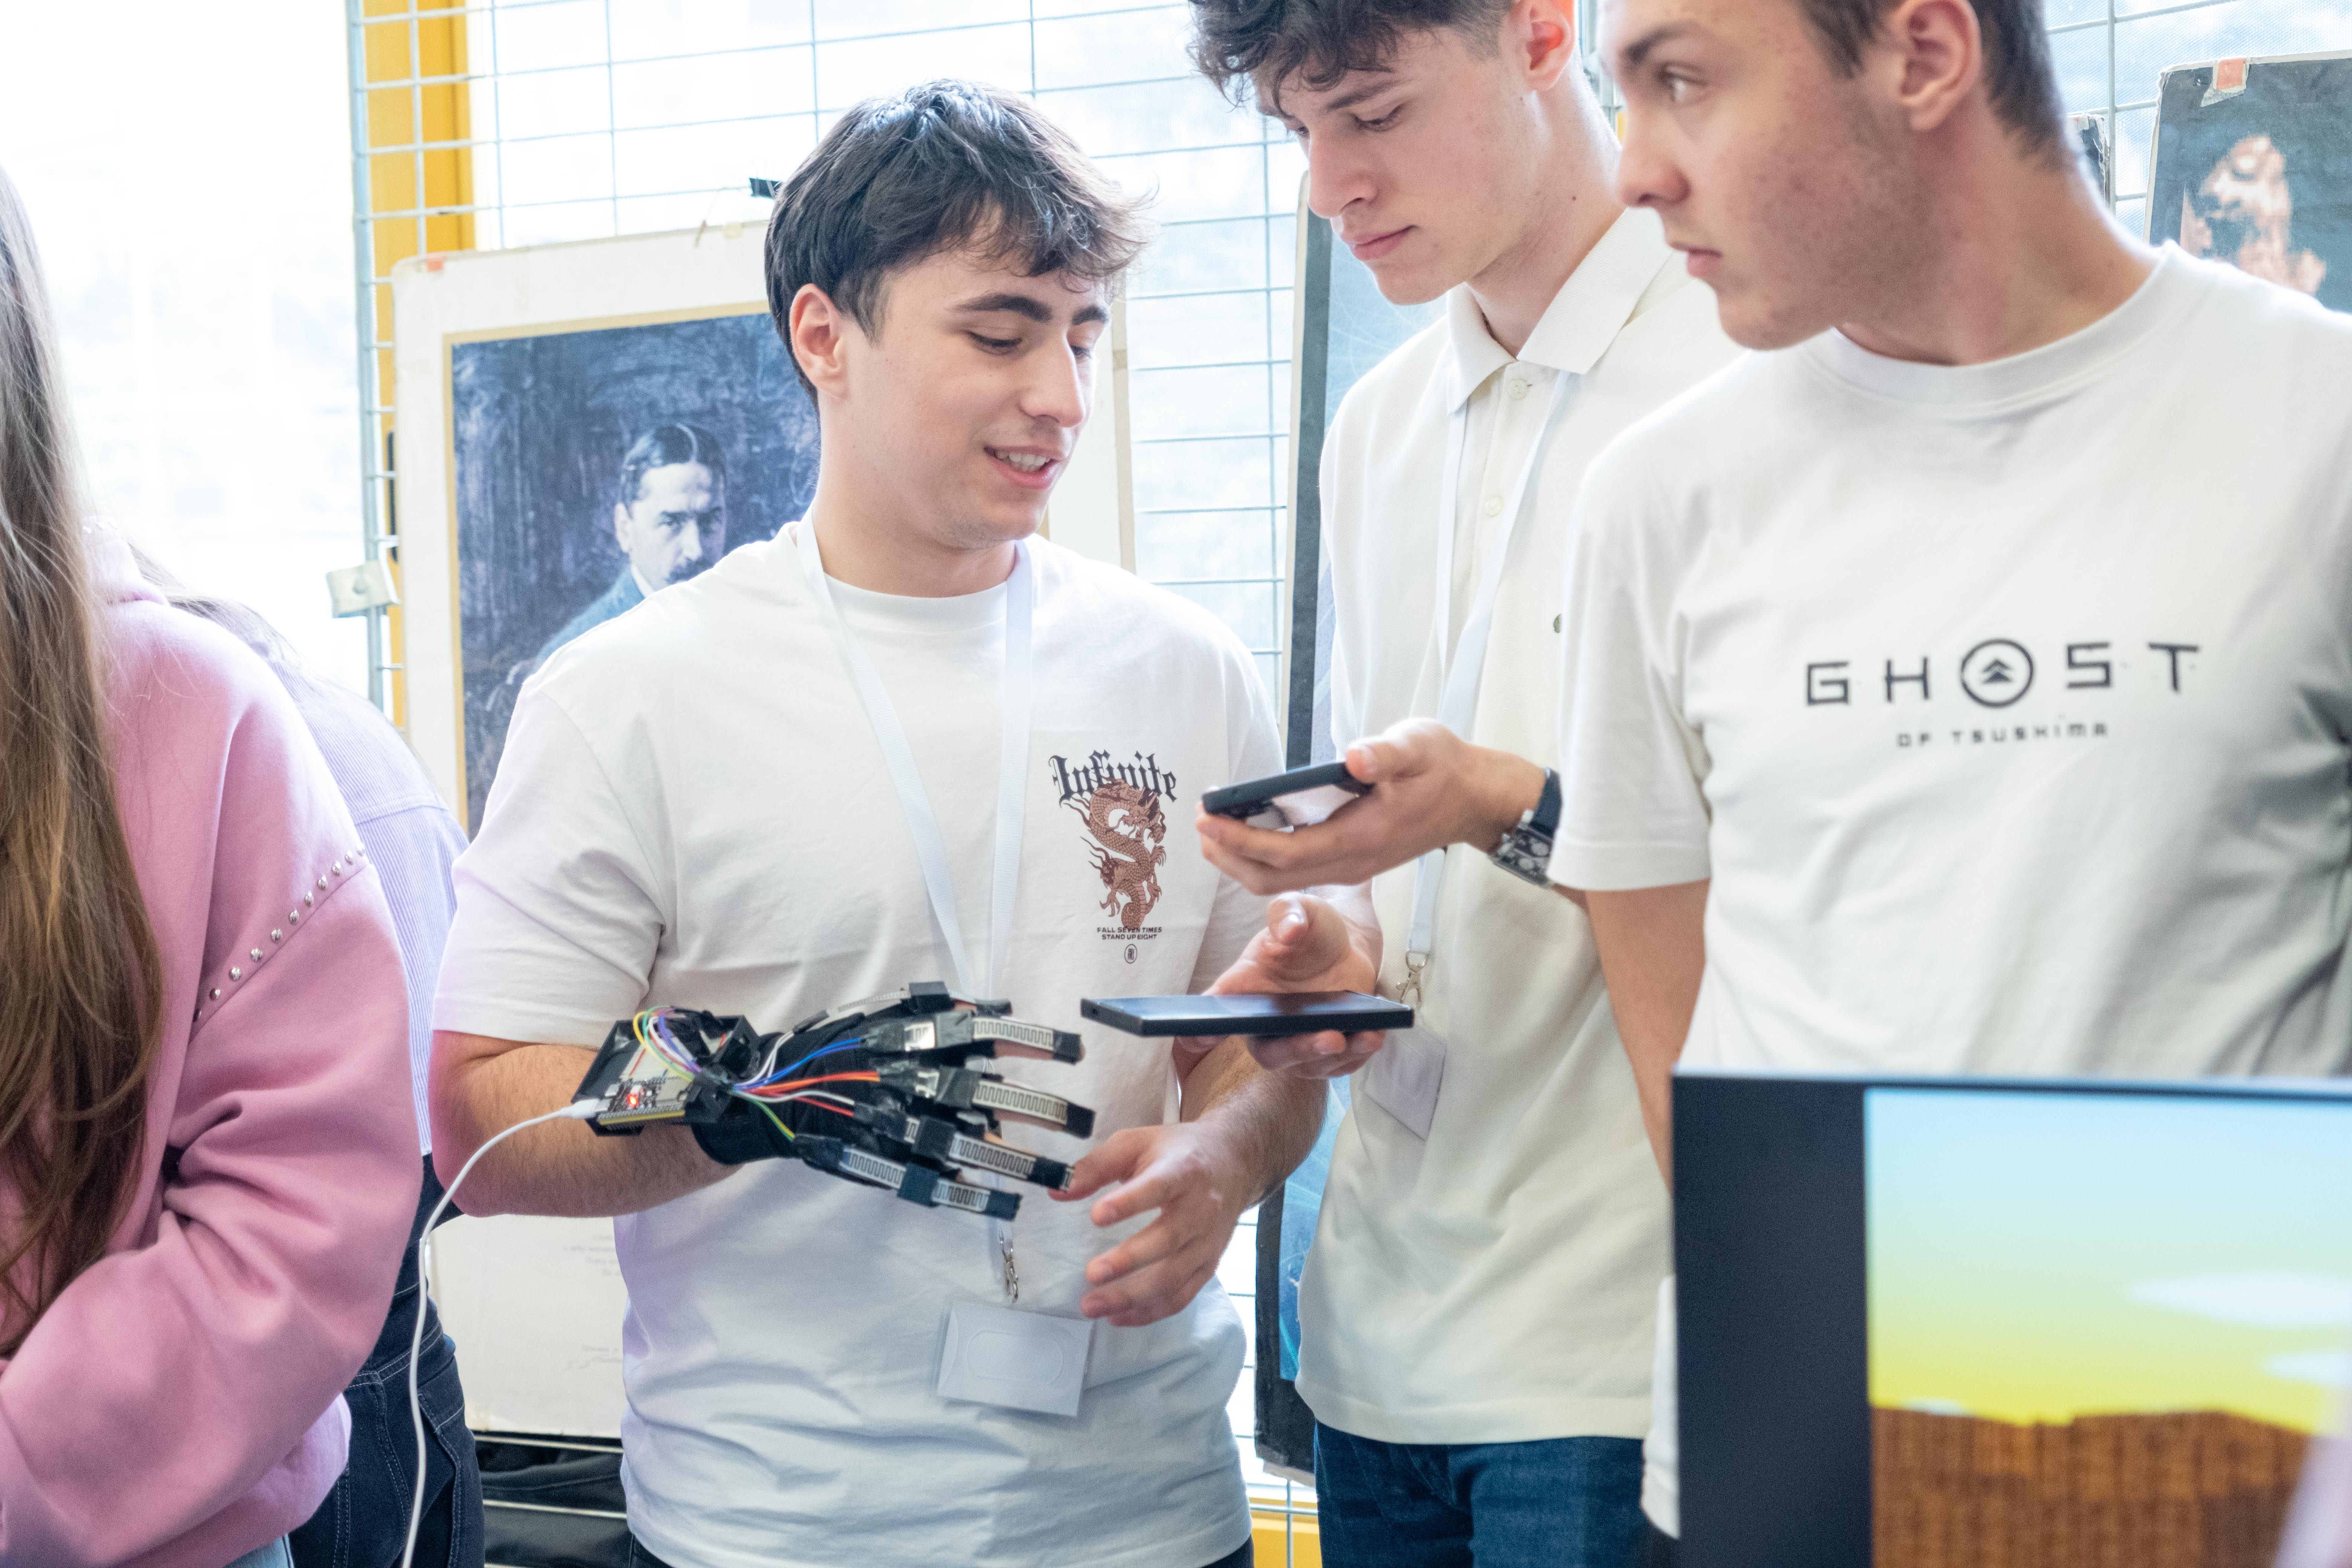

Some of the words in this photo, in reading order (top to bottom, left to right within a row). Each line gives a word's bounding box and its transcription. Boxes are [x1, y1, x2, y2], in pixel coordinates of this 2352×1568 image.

[1807, 638, 2200, 708] GHOST
[1896, 732, 1932, 747] OF
[1048, 749, 1178, 808] Infinite
